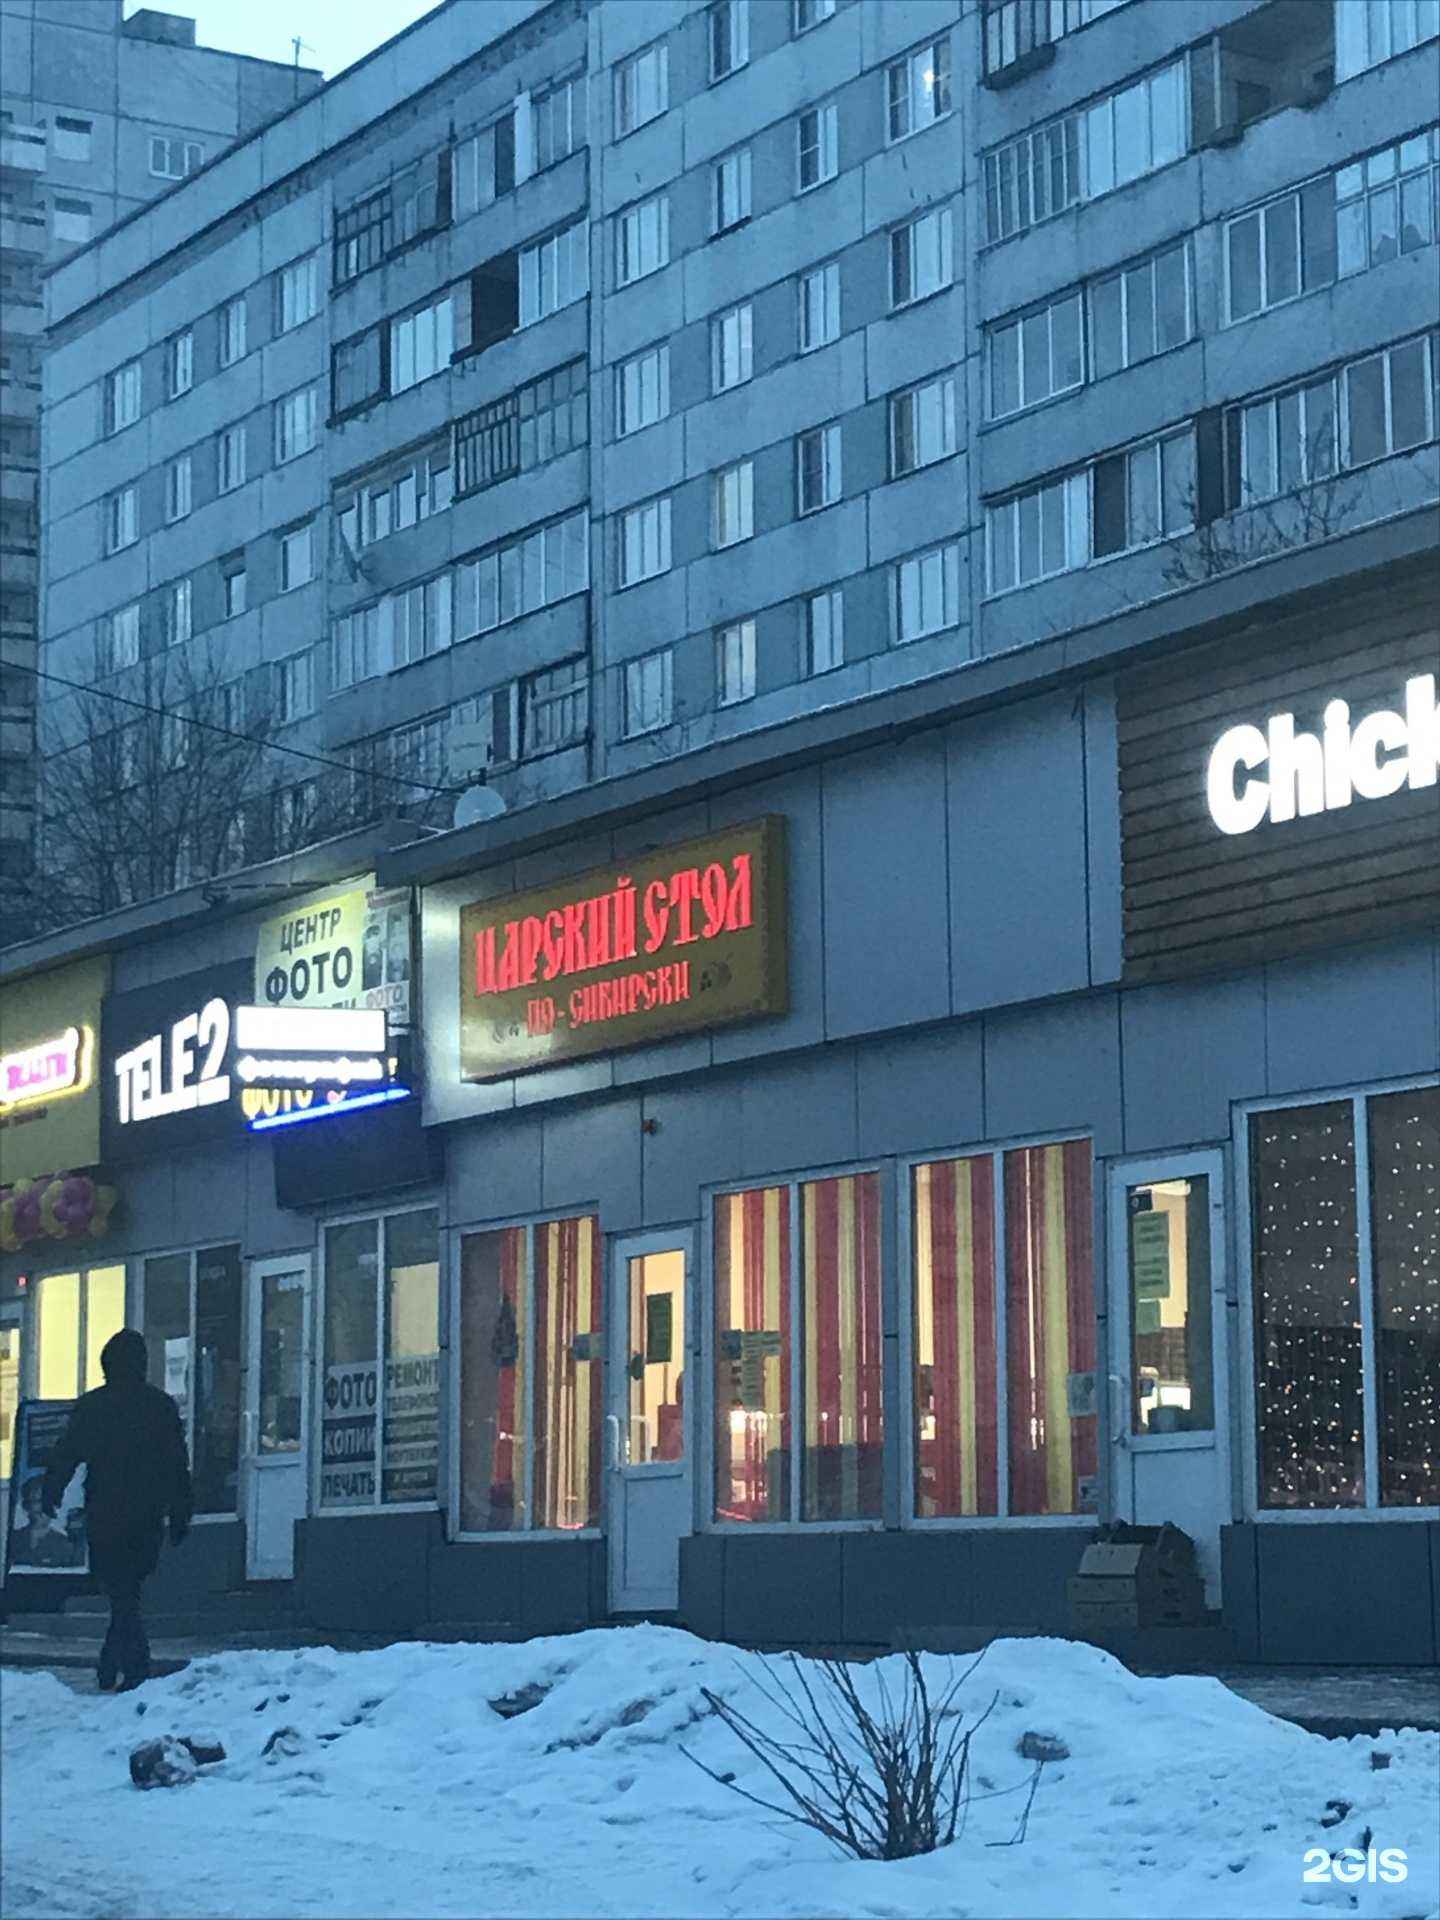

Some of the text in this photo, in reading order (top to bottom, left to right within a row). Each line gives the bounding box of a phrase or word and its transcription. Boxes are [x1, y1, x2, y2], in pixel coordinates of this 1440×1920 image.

[280, 907, 341, 953] ЦЕНТР
[475, 853, 753, 997] ЦАРСКИЙ СТОЛ
[266, 946, 353, 1006] ФОТО
[114, 997, 231, 1124] TELE2
[326, 1371, 377, 1410] ФОТО
[323, 1471, 376, 1499] ПЕЧАТЬ
